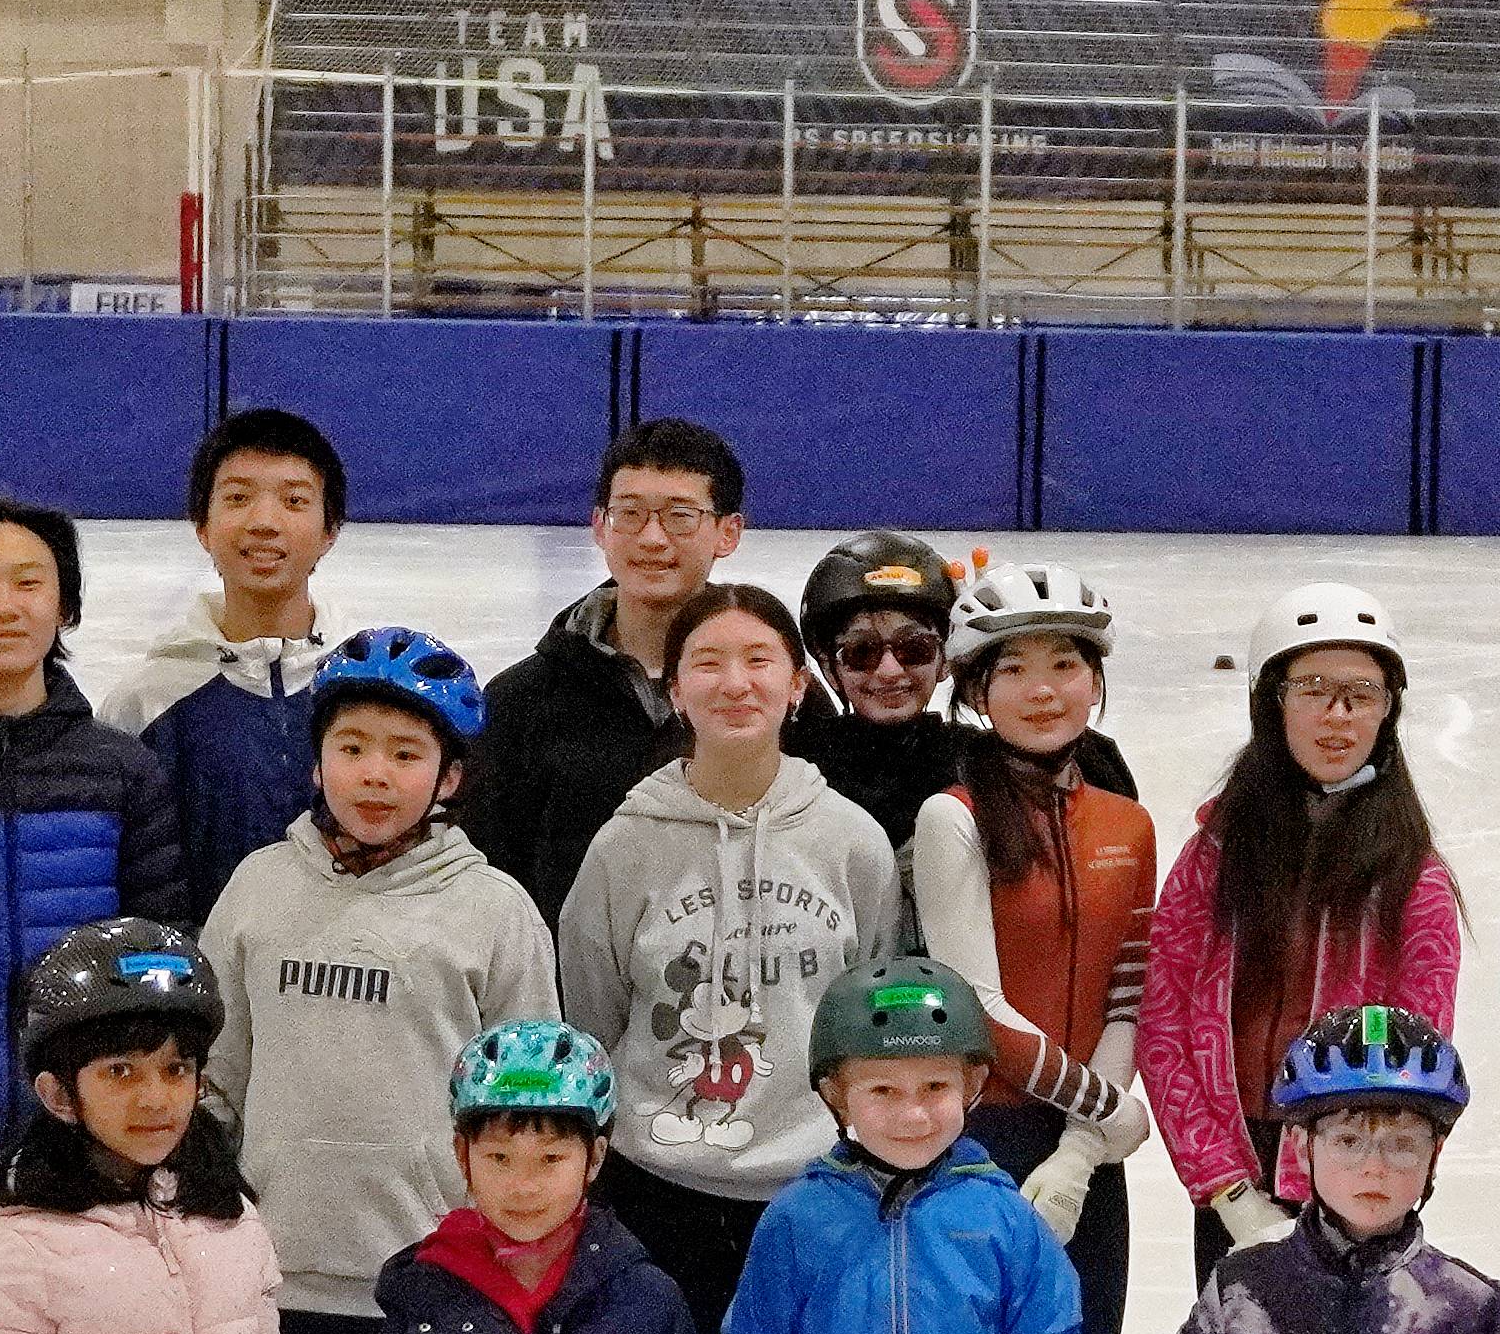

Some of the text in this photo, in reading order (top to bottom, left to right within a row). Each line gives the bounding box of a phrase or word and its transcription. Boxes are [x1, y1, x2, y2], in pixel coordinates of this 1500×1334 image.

[455, 10, 588, 48] TEAM
[435, 57, 614, 160] USA
[664, 879, 841, 931] LES SPORTS
[279, 959, 390, 1003] PUMA
